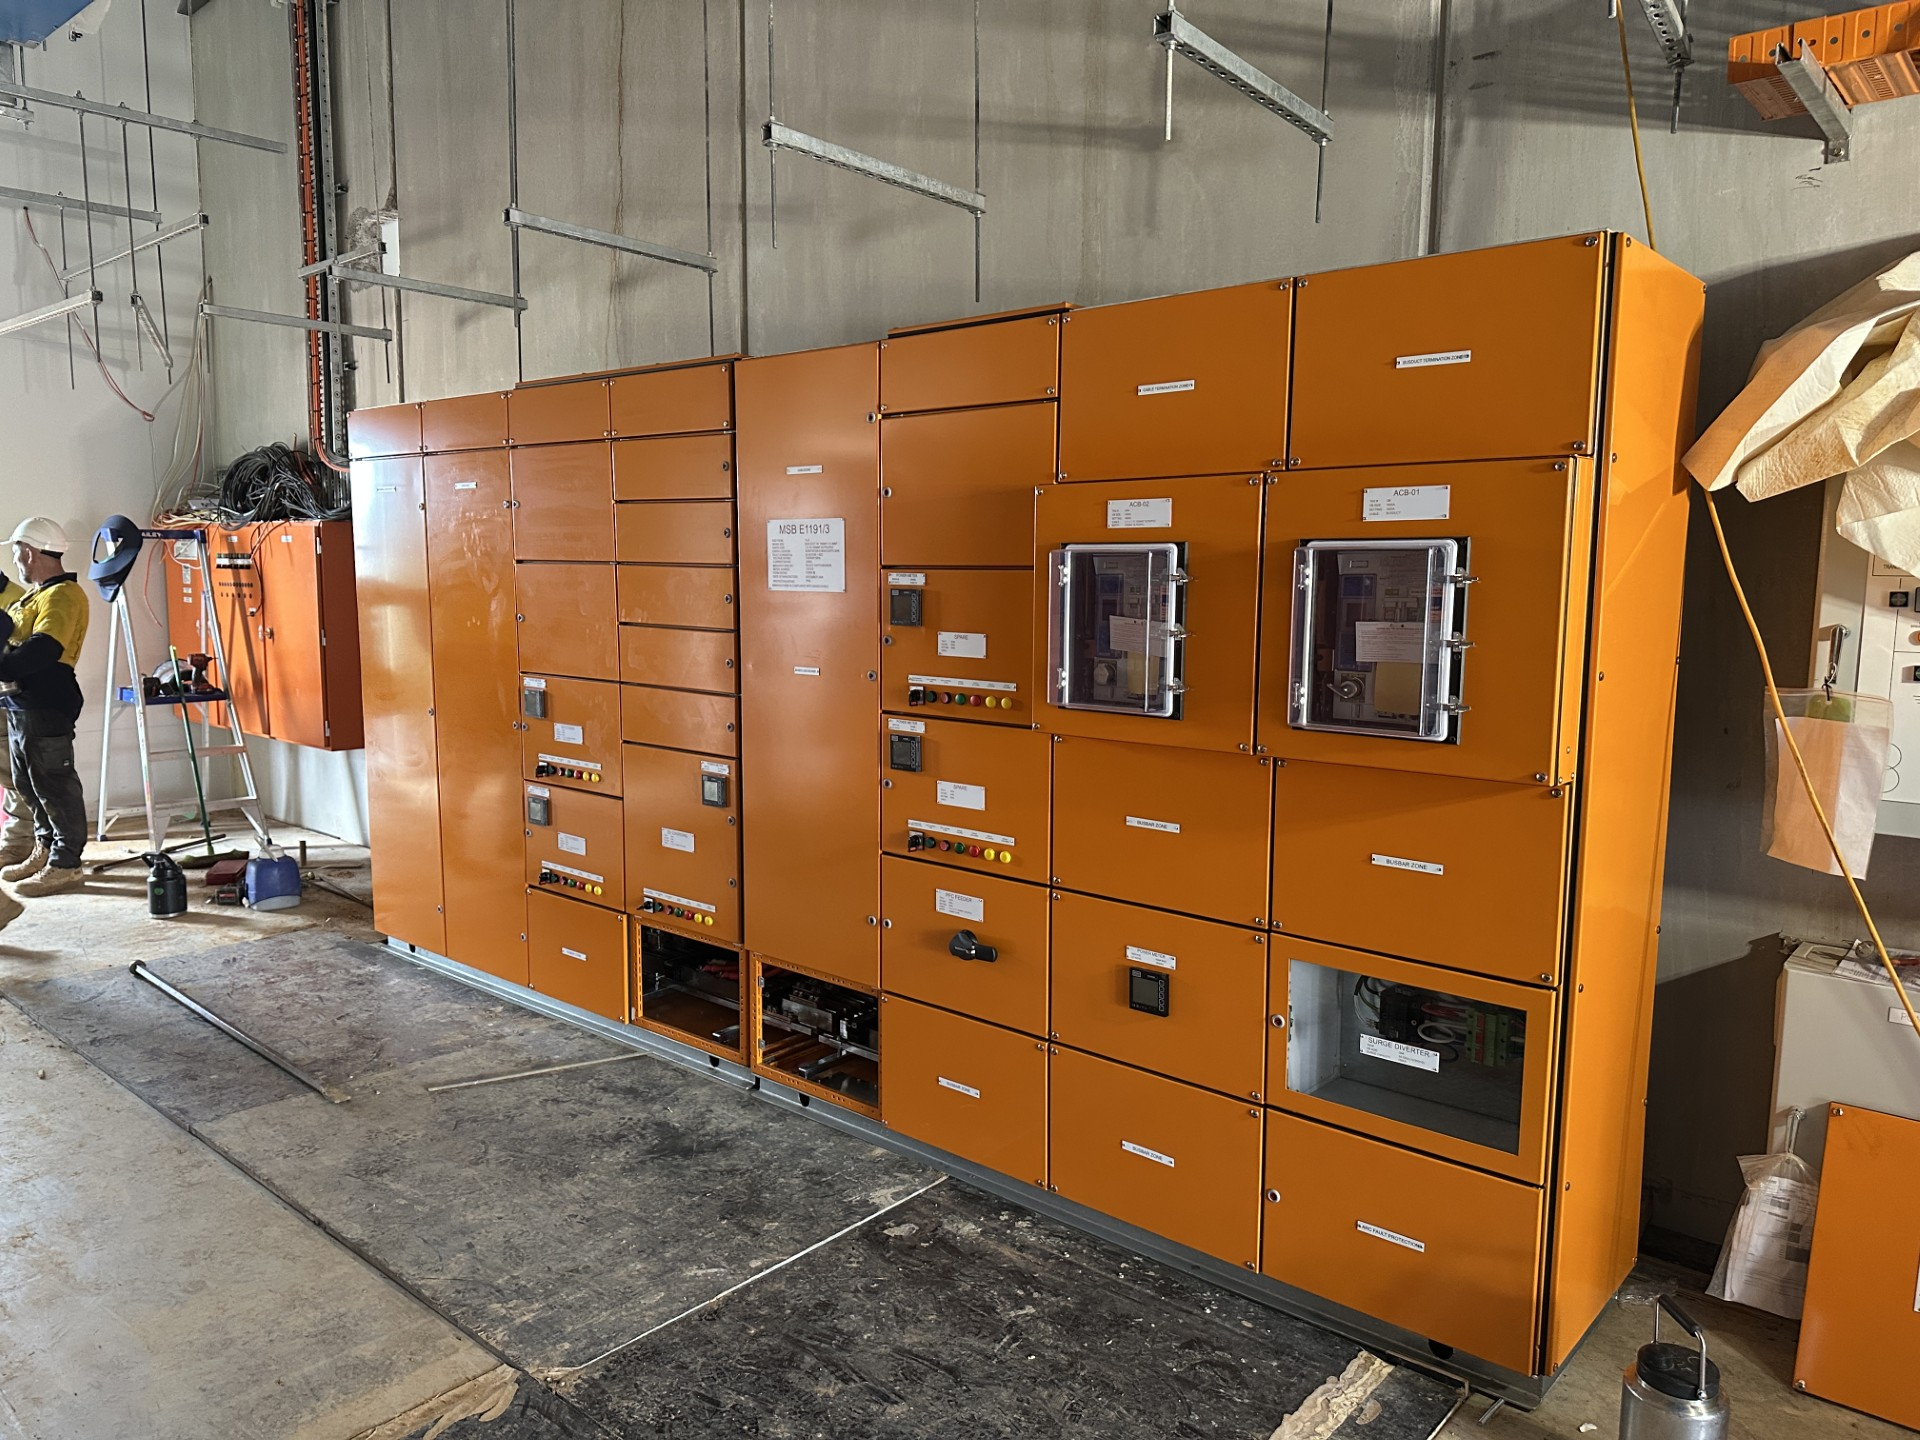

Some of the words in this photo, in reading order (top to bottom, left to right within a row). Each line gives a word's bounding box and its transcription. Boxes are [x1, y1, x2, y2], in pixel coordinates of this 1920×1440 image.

[1393, 488, 1420, 497] ACB-01
[779, 524, 797, 535] MSB
[799, 524, 830, 535] E1191/3
[953, 633, 969, 641] SPARE
[1386, 859, 1410, 867] BUSBAR
[1410, 862, 1427, 870] ZONE
[954, 894, 972, 903] FEEDER
[1367, 1036, 1393, 1049] SURGE
[1394, 1043, 1430, 1058] DIVERTER
[1132, 1146, 1150, 1156] BUSBAR
[1150, 1152, 1162, 1161] ZONE
[1361, 1224, 1372, 1232] ARC
[1372, 1228, 1388, 1237] FAULT
[1388, 1233, 1420, 1248] PROTECTION
